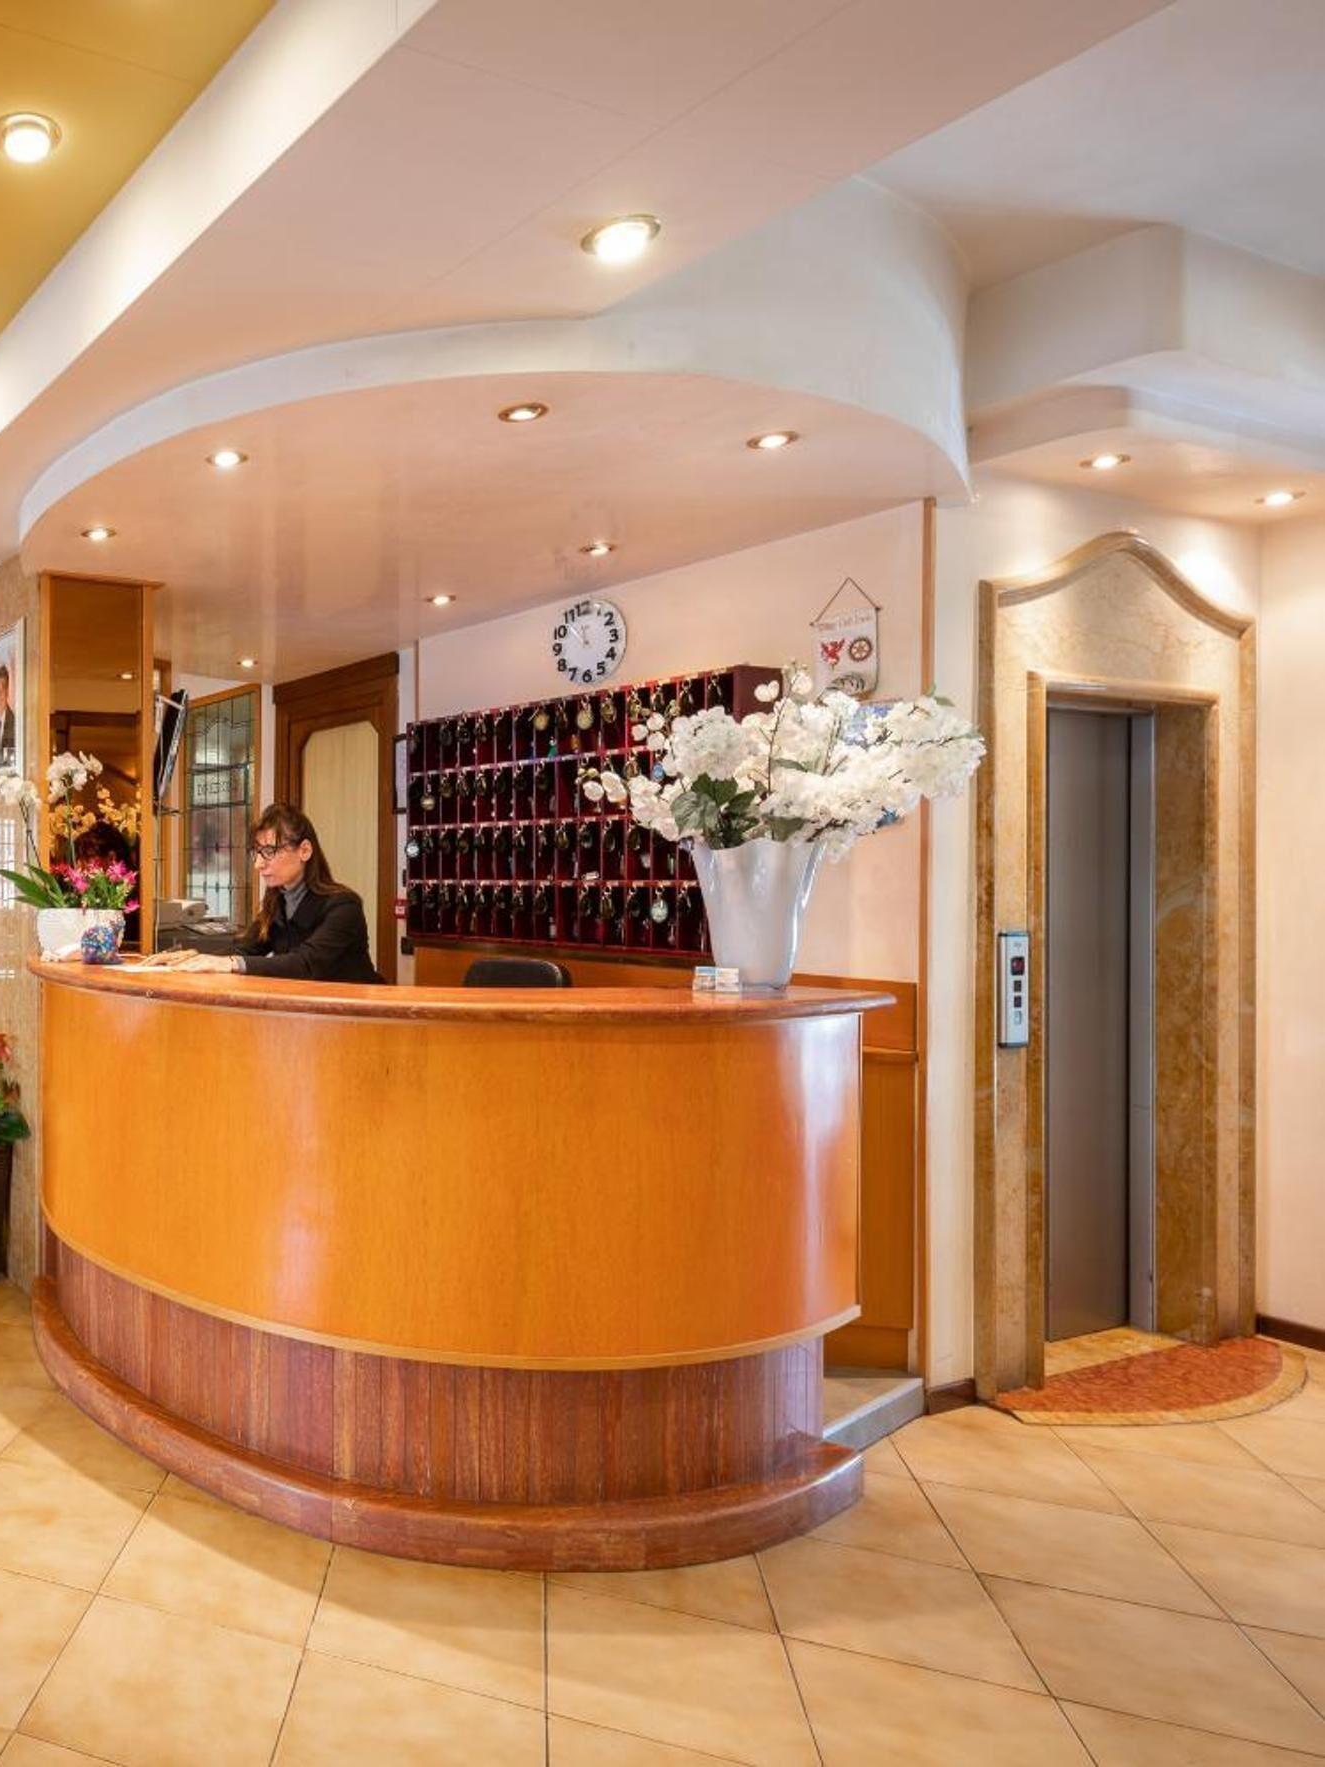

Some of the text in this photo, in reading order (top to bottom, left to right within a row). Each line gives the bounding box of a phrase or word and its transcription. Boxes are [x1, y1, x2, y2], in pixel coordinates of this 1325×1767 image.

[564, 609, 575, 624] 11
[604, 612, 615, 626] 2
[554, 625, 567, 640] 10
[609, 628, 619, 643] 3
[552, 643, 562, 656] 9
[605, 646, 616, 661] 4
[557, 658, 567, 672] 8
[596, 661, 606, 676] 5
[568, 667, 578, 682] 7
[582, 669, 593, 684] 6
